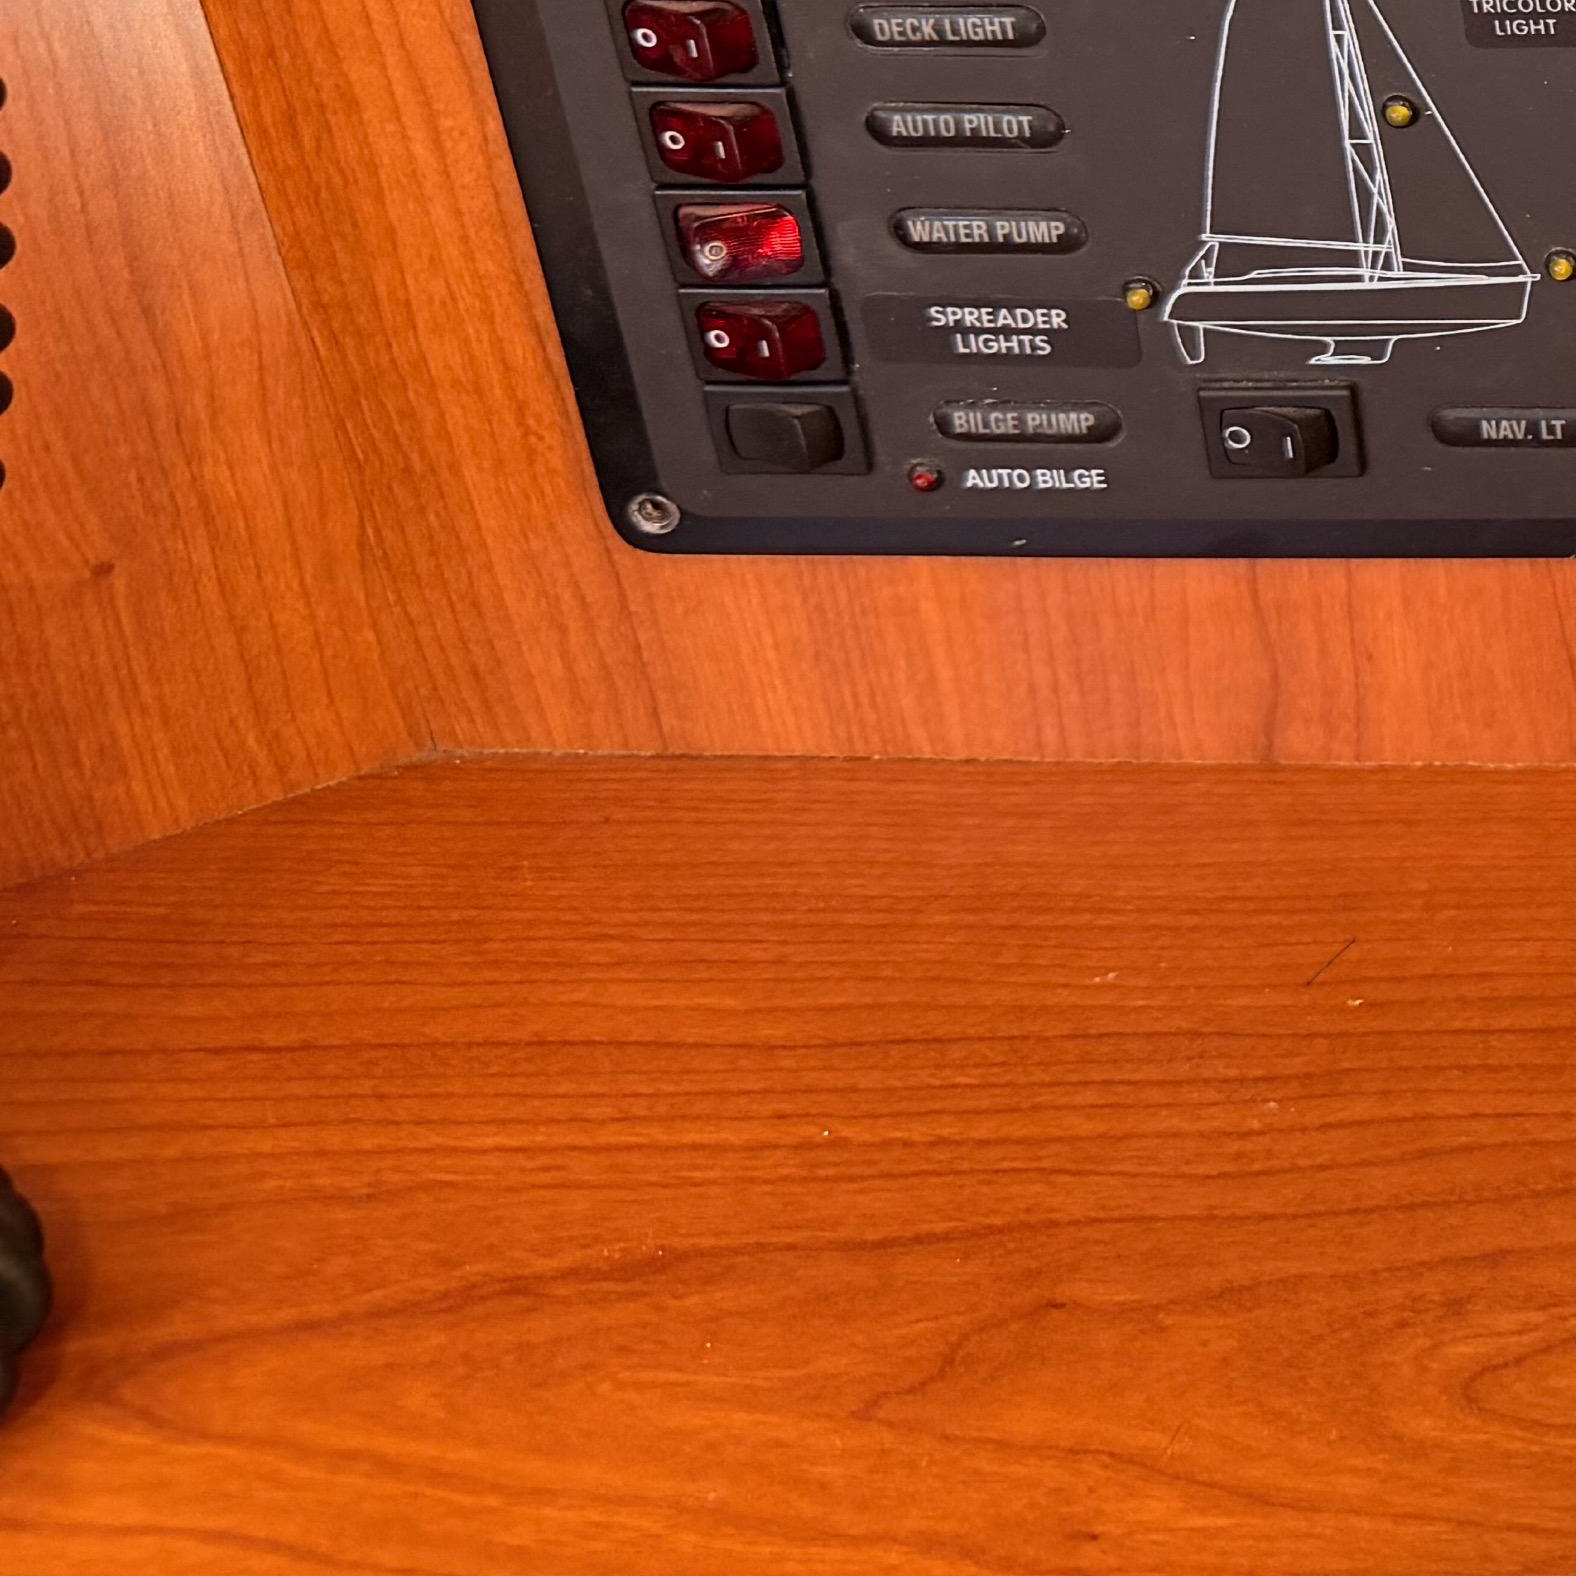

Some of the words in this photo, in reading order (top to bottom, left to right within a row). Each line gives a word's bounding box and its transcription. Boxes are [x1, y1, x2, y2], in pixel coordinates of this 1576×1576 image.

[873, 17, 940, 41] DECK
[946, 16, 1016, 42] LIGHT
[1495, 18, 1556, 36] LIGHT
[891, 115, 959, 138] AUTO
[964, 115, 1033, 139] PILOT
[907, 220, 990, 243] WATER
[996, 221, 1065, 243] PUMP
[930, 306, 1068, 330] SPREADER
[955, 333, 1052, 356] LIGHTS
[953, 411, 1021, 434] BILGE
[1026, 412, 1095, 436] PUMP
[1481, 419, 1533, 441] NAV.
[1541, 420, 1566, 440] LT
[964, 468, 1031, 490] AUTO
[1036, 468, 1107, 490] BILGE
